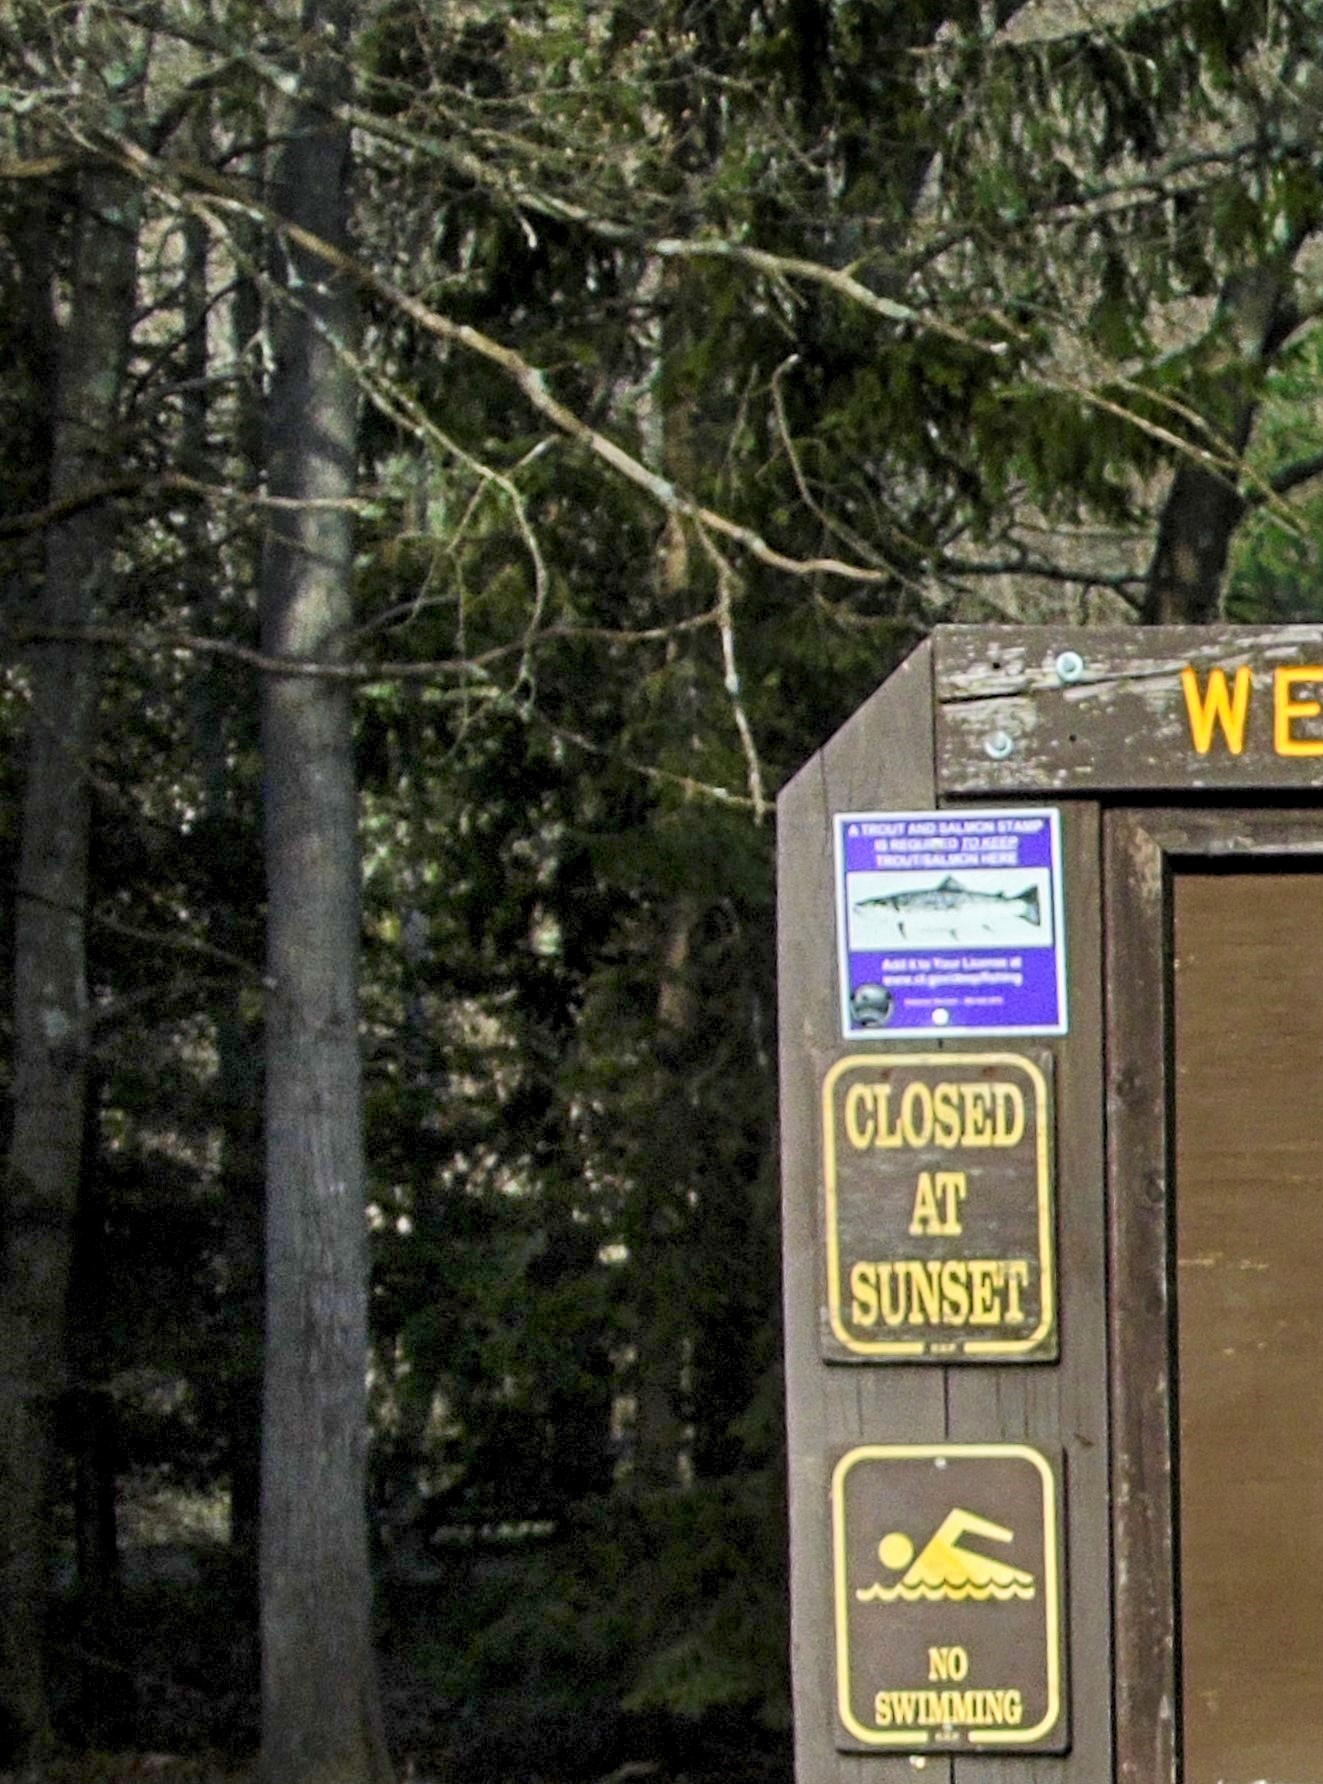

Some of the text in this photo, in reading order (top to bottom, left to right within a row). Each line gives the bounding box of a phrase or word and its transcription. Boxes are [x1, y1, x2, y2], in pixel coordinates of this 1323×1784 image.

[844, 1082, 1026, 1150] CLOSED
[910, 1172, 967, 1236] AT
[850, 1260, 1028, 1327] SUNSET
[928, 1646, 968, 1683] NO
[875, 1690, 1021, 1727] SWIMMING
